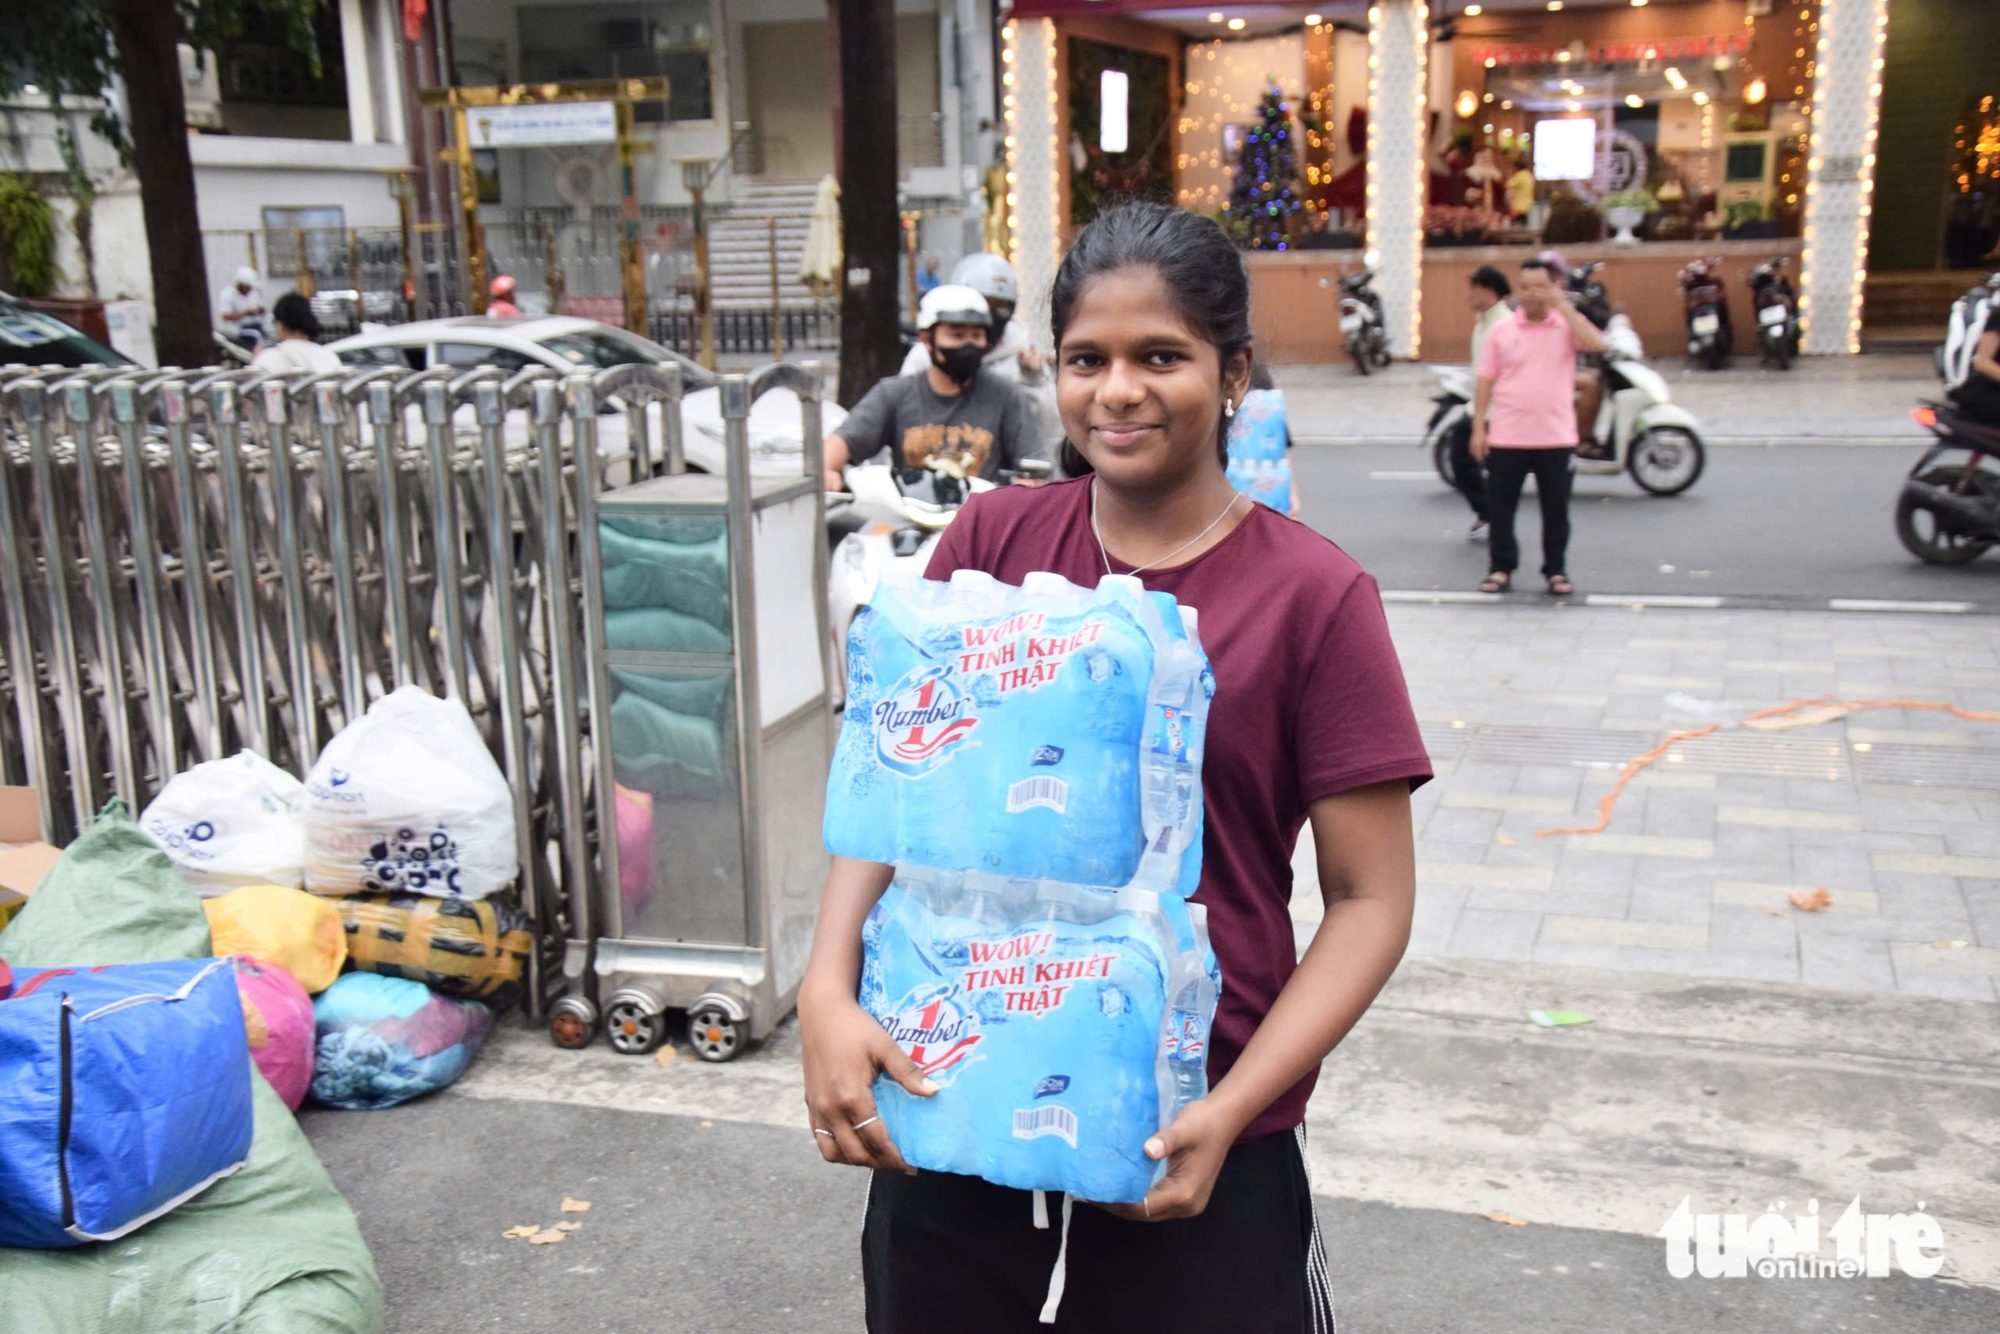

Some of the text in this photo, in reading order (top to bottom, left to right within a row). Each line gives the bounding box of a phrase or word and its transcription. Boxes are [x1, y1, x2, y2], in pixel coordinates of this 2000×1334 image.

[959, 618, 1107, 674] TINH KHIẾT
[964, 612, 1044, 648] WOW!
[1000, 659, 1063, 692] THẬT
[875, 690, 971, 734] Number
[969, 933, 1053, 964] WOW!
[965, 944, 1118, 992] TINH KHIẾT
[1005, 984, 1069, 1017] THẬT
